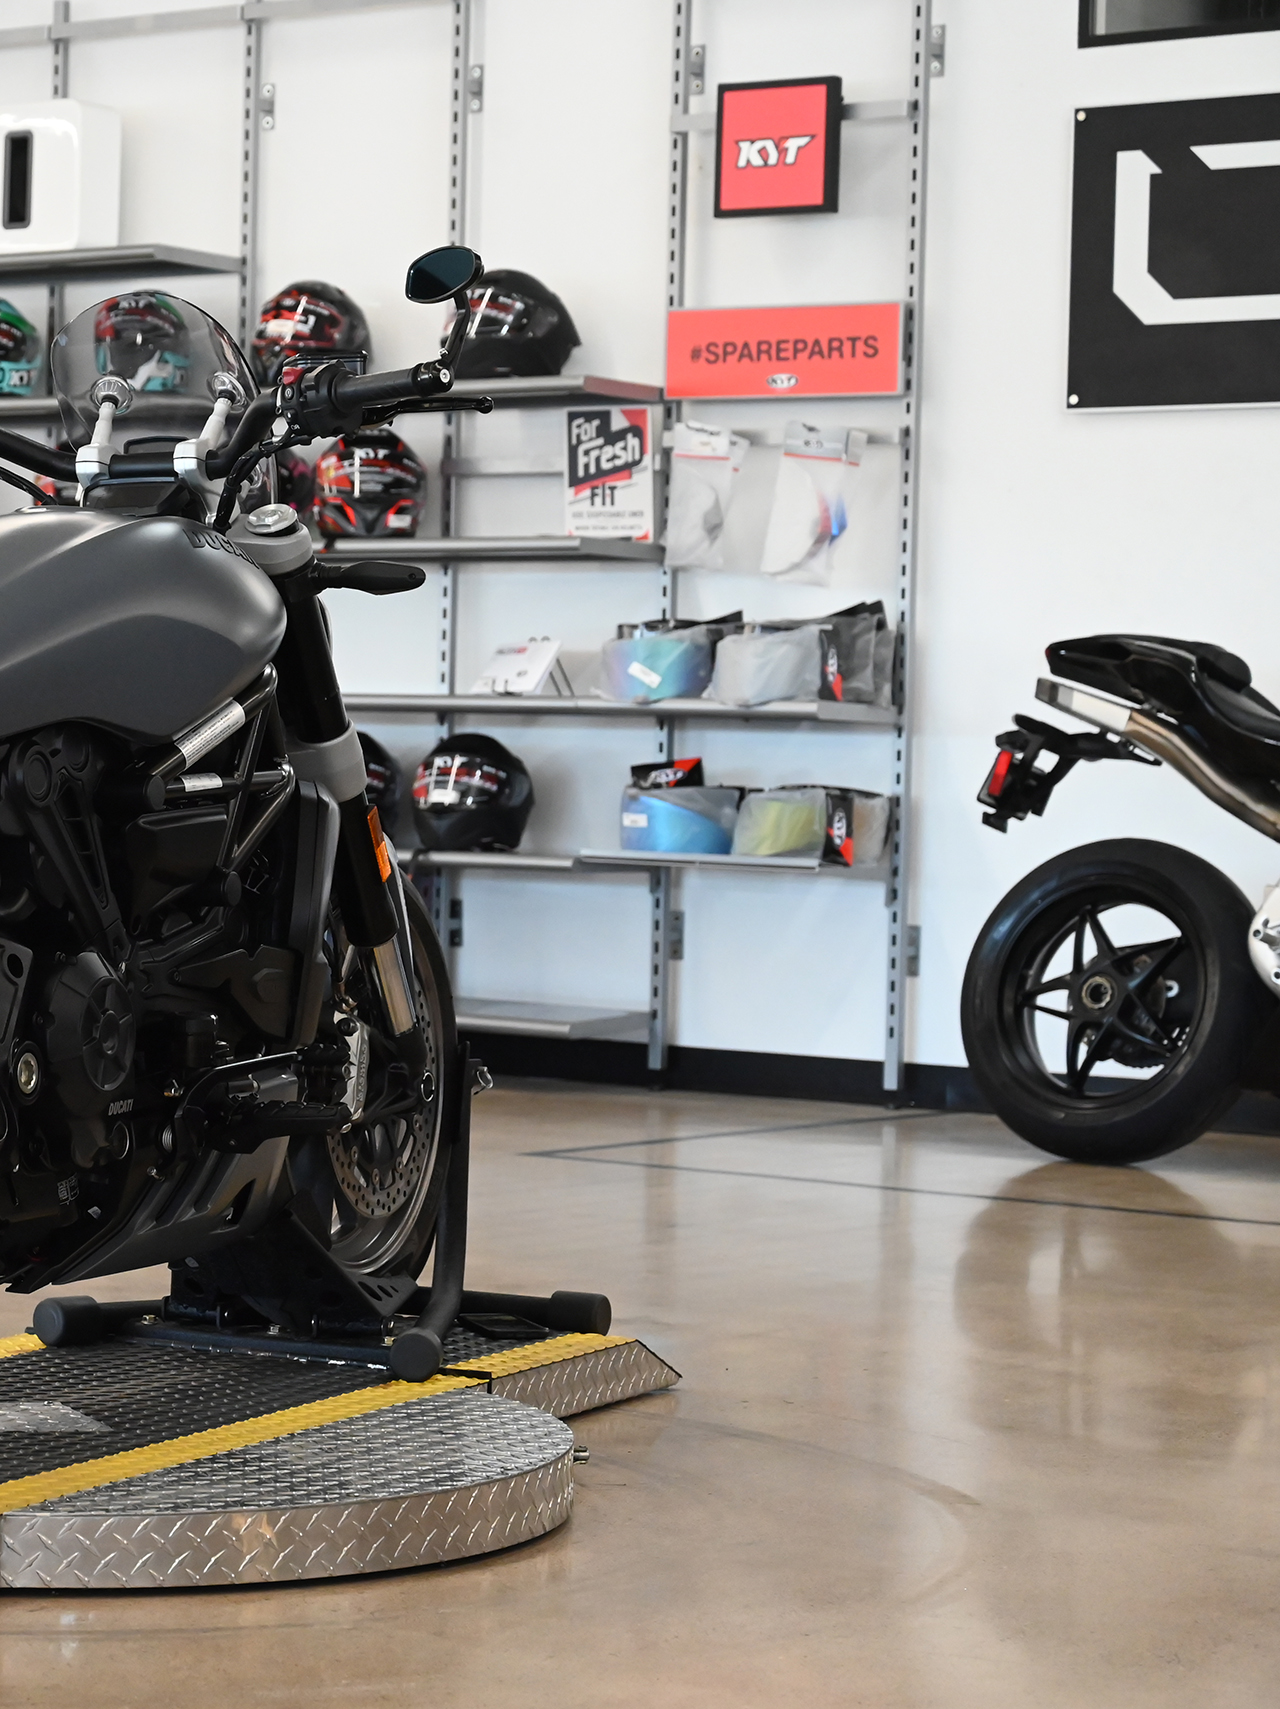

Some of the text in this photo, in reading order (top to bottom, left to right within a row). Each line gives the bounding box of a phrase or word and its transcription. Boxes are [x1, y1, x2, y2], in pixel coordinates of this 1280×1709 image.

[735, 135, 816, 168] KYT
[691, 335, 879, 365] #SPAREPARTS
[571, 417, 601, 446] For
[577, 432, 641, 478] Fresh
[590, 483, 618, 506] FIT
[108, 1099, 134, 1116] DUCATI
